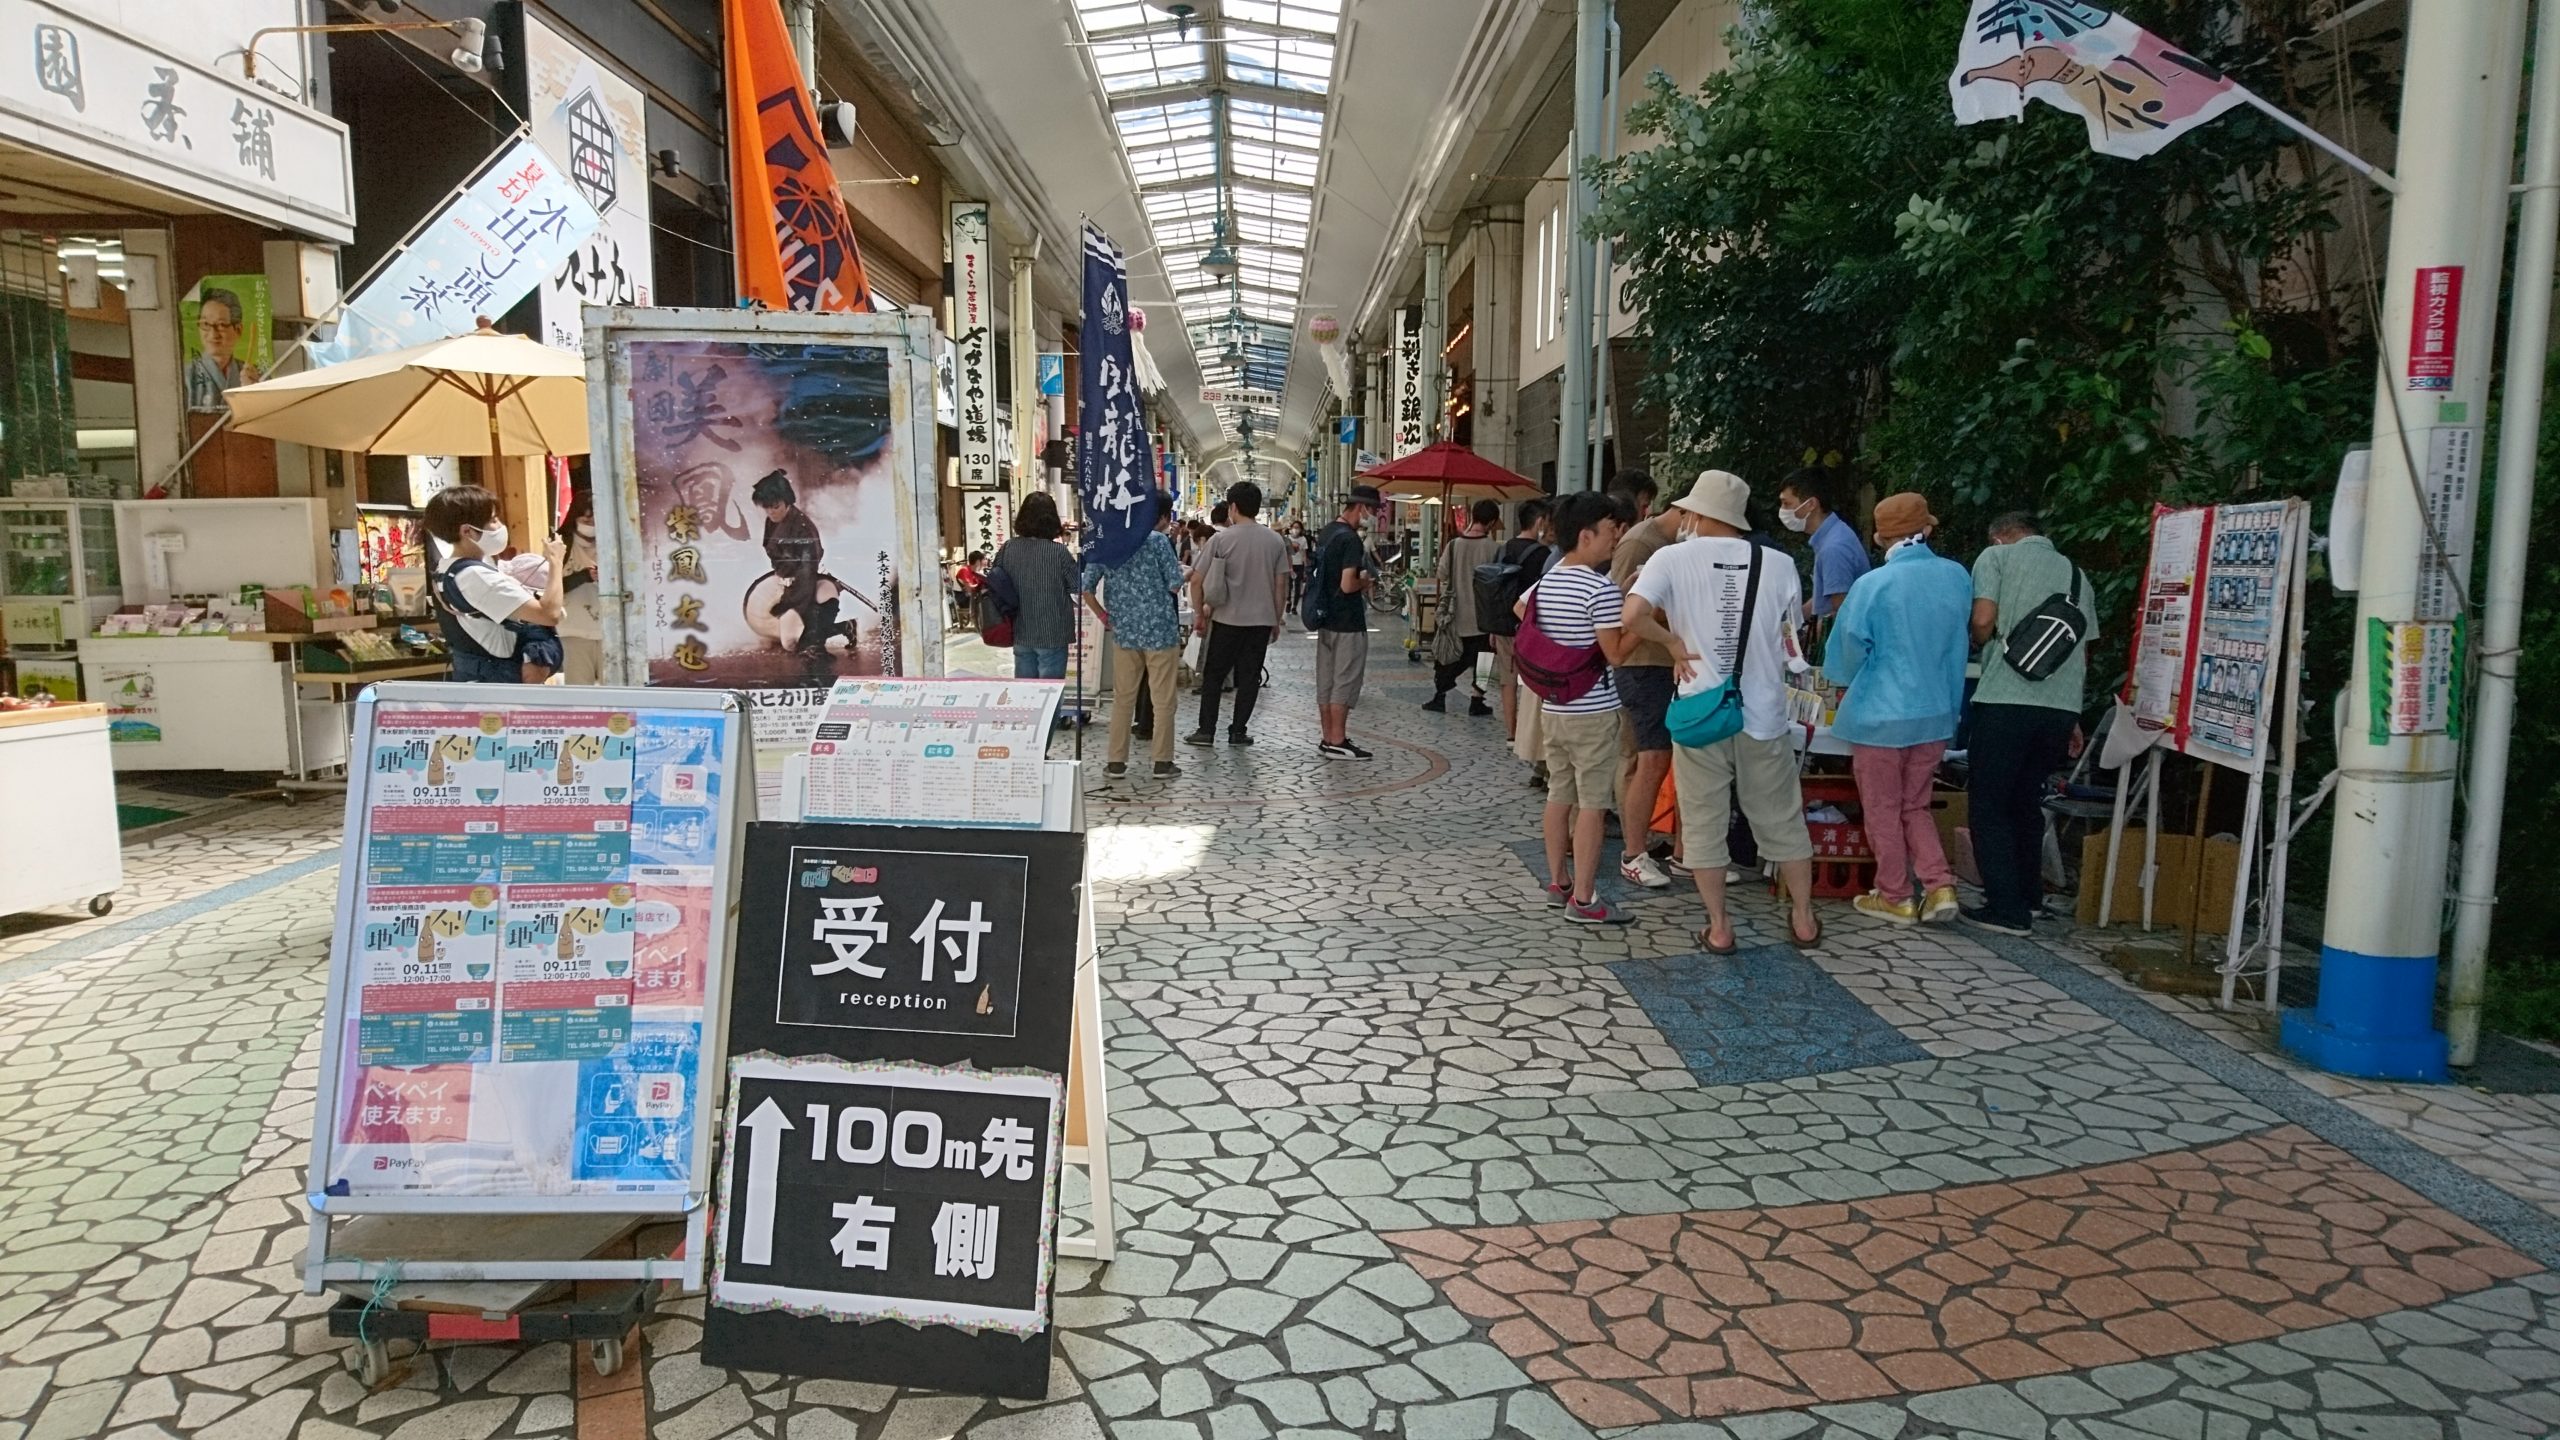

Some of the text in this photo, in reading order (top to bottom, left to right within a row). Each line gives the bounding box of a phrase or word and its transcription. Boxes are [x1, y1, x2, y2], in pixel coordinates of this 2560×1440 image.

[2425, 272, 2450, 353] 監視カメラ設置
[642, 353, 675, 425] 劇団
[959, 326, 988, 444] さかなや道場
[2408, 377, 2454, 388] SECOM
[964, 453, 991, 466] 130
[971, 469, 983, 481] 席
[413, 787, 448, 797] 09.11
[543, 786, 577, 797] 09.11
[810, 895, 993, 984] 受付
[403, 963, 438, 974] 09.11
[543, 961, 578, 972] 09.11
[839, 990, 948, 1010] reception
[364, 1081, 449, 1101] ペイペイ
[361, 1105, 453, 1126] 使えます。
[806, 1103, 1035, 1182] 100m先
[389, 1158, 426, 1169] PayPay
[830, 1195, 1000, 1280] 右側
